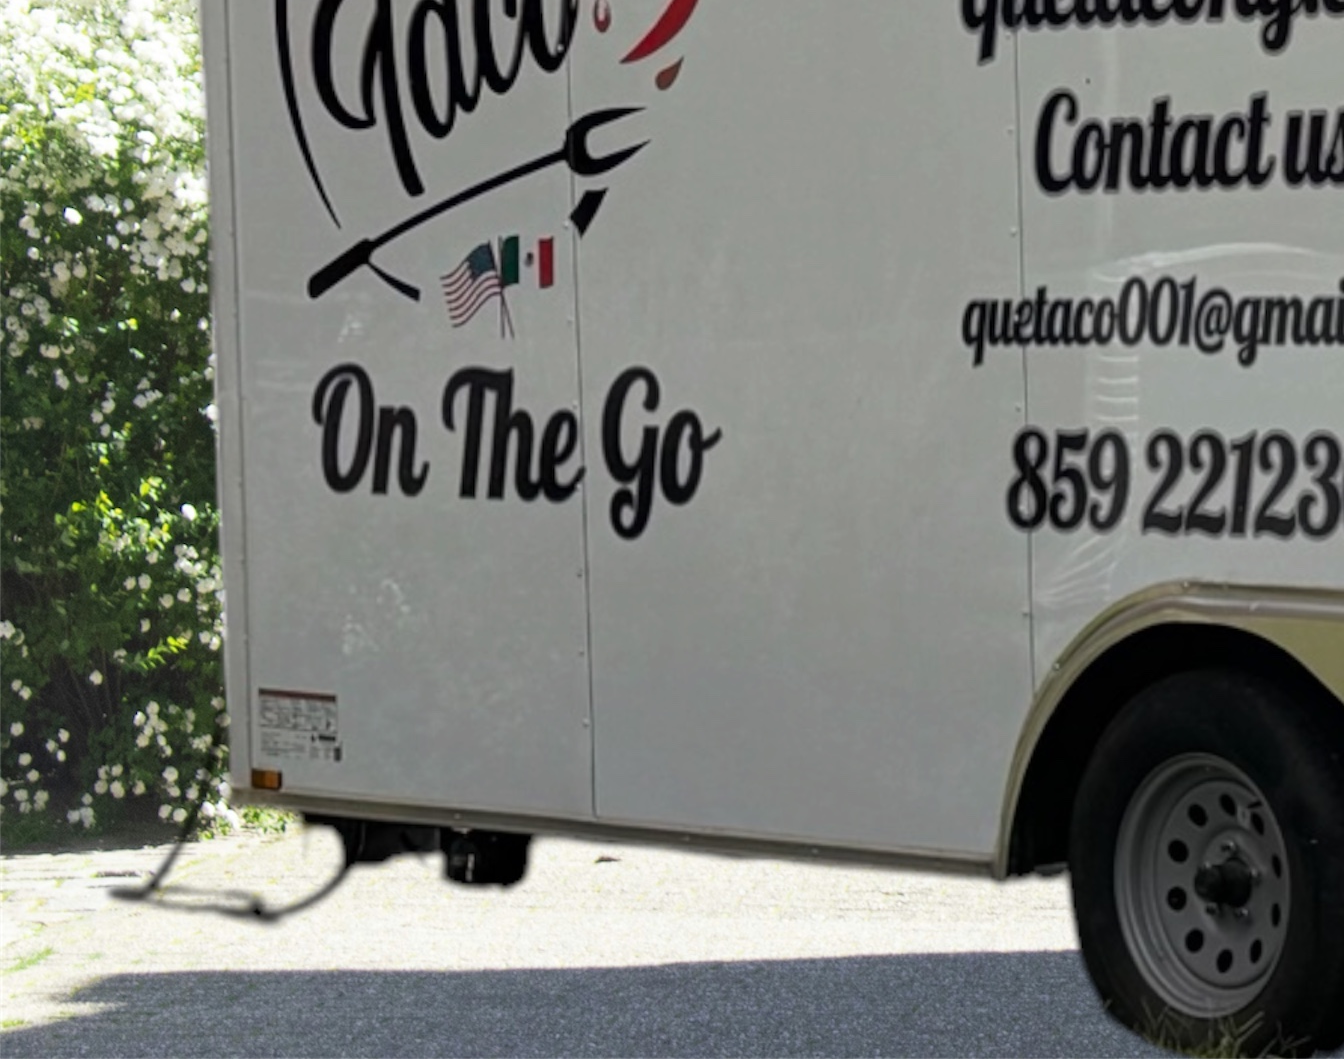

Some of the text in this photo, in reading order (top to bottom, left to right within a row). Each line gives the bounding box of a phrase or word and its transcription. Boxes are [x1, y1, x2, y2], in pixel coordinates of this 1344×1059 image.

[1034, 88, 1276, 194] Contact
[312, 362, 723, 542] On The Go
[1006, 426, 1132, 534] 859
